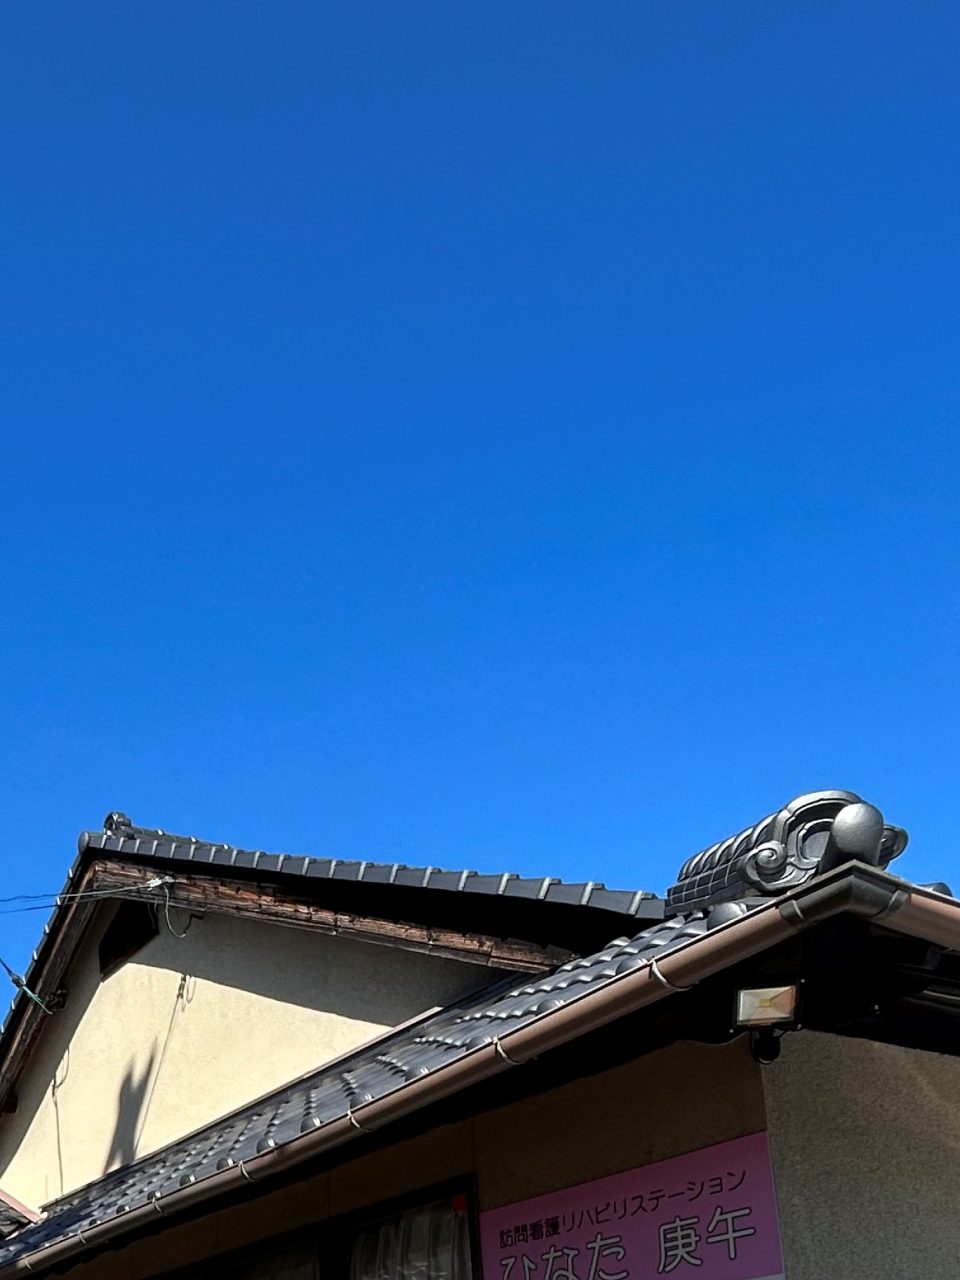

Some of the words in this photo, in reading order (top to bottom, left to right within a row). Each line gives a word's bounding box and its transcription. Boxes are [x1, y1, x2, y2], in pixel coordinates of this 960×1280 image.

[499, 1170, 746, 1249] 訪問看護リハビリステーション
[657, 1205, 756, 1274] 庚午
